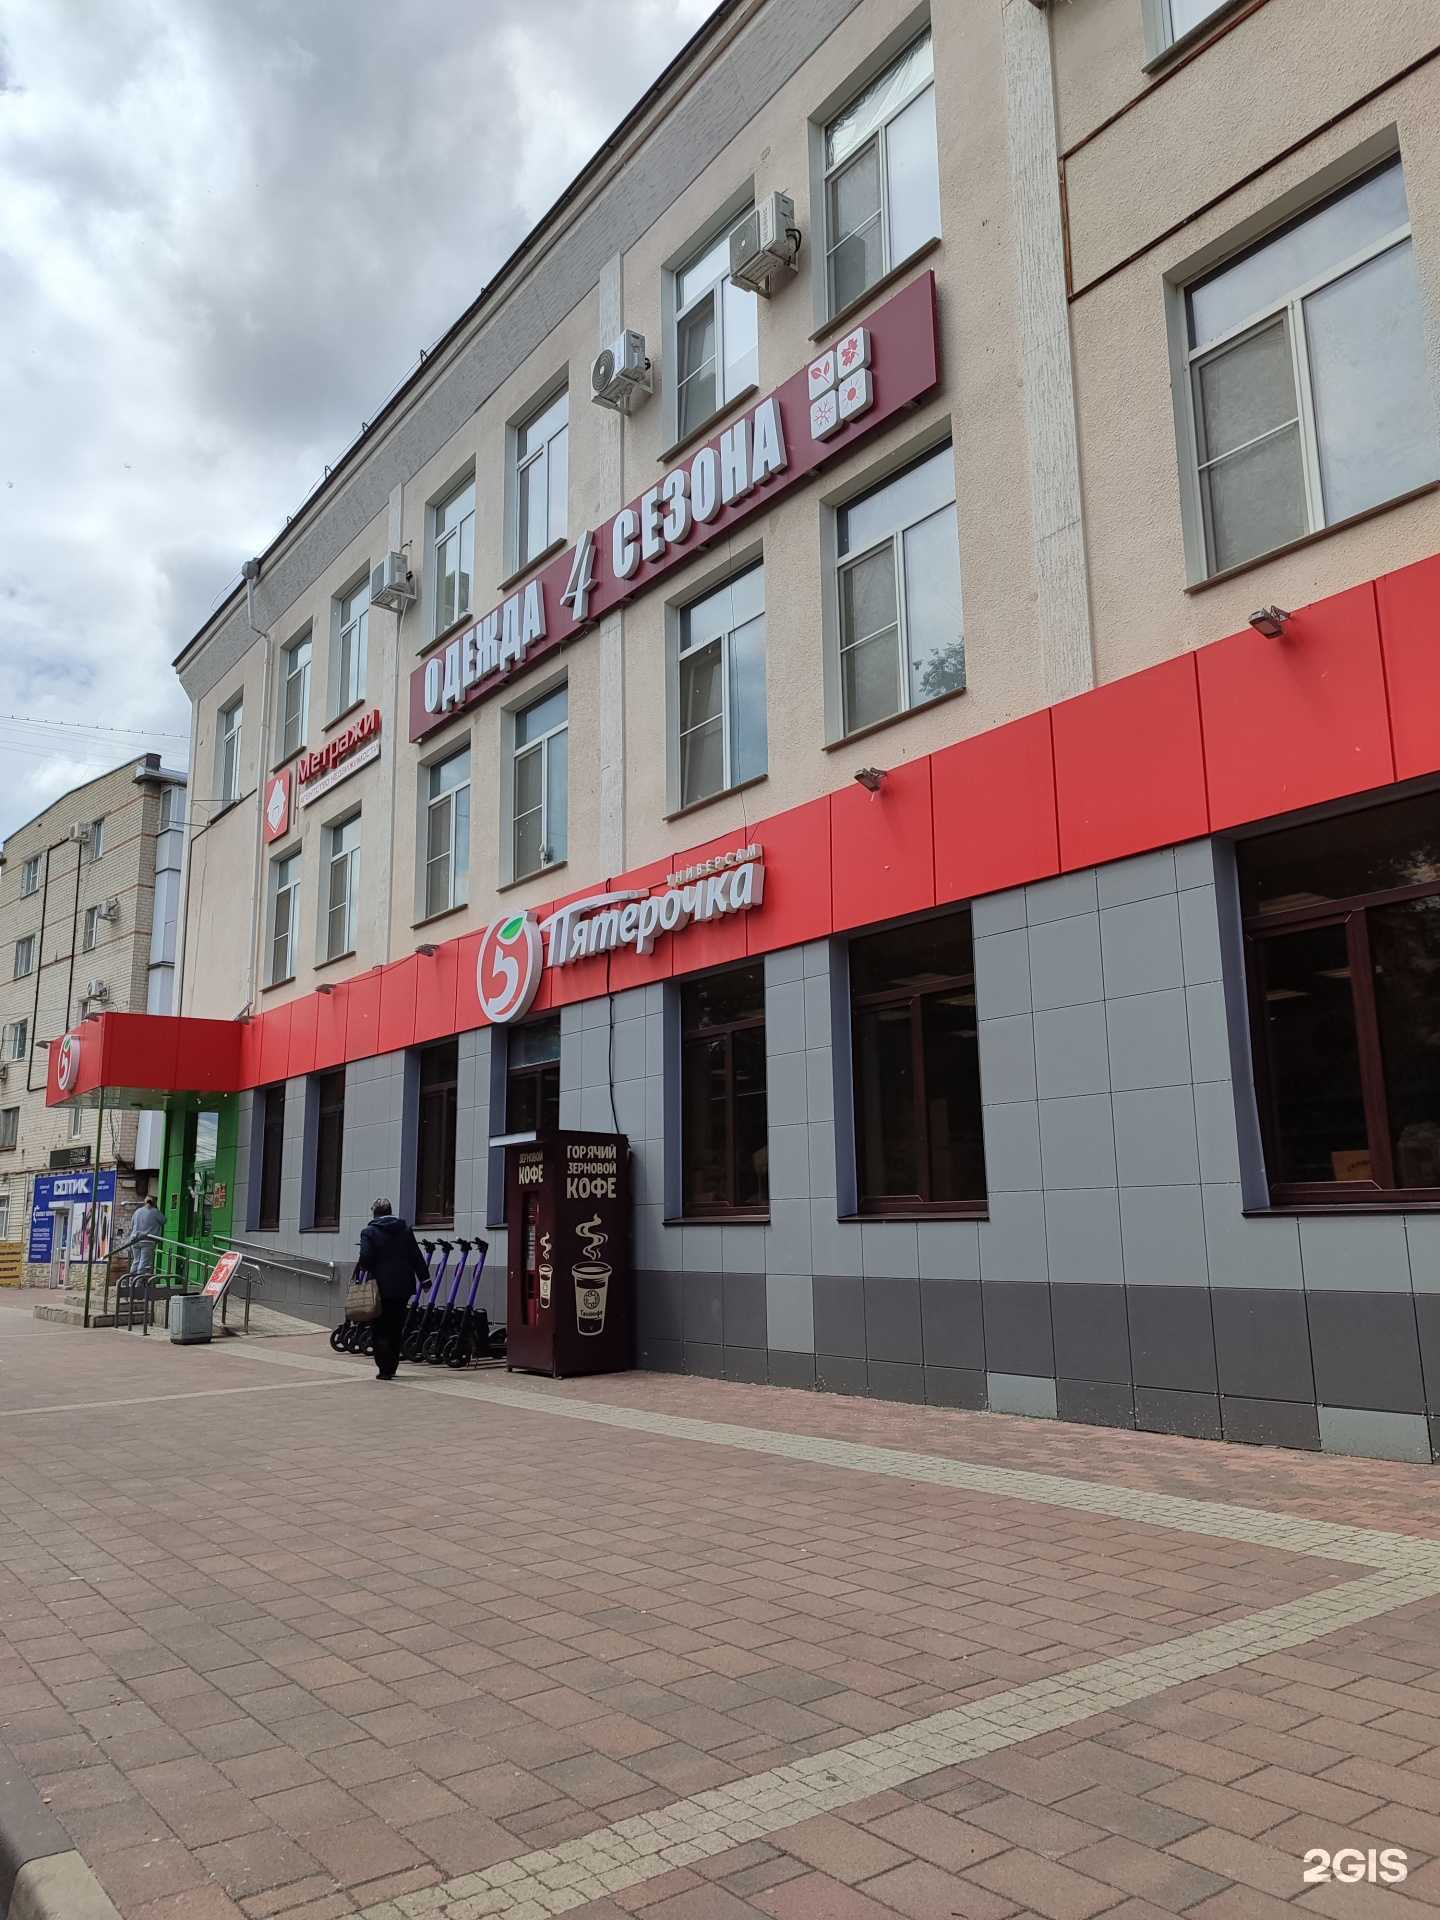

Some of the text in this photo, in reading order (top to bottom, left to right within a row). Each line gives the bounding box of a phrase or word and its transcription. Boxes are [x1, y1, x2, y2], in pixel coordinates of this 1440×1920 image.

[424, 397, 788, 714] ОДЕЖДА 4 СЕЗОНА
[298, 709, 382, 784] Метражи
[666, 842, 763, 888] УНИВЕРСАМ
[538, 862, 765, 968] Пятерочка
[567, 1144, 617, 1159] ГОРЯЧИЙ
[567, 1160, 617, 1175] ЗЕРНОВОЙ
[518, 1164, 544, 1185] КОФЕ
[566, 1177, 617, 1199] КОФЕ
